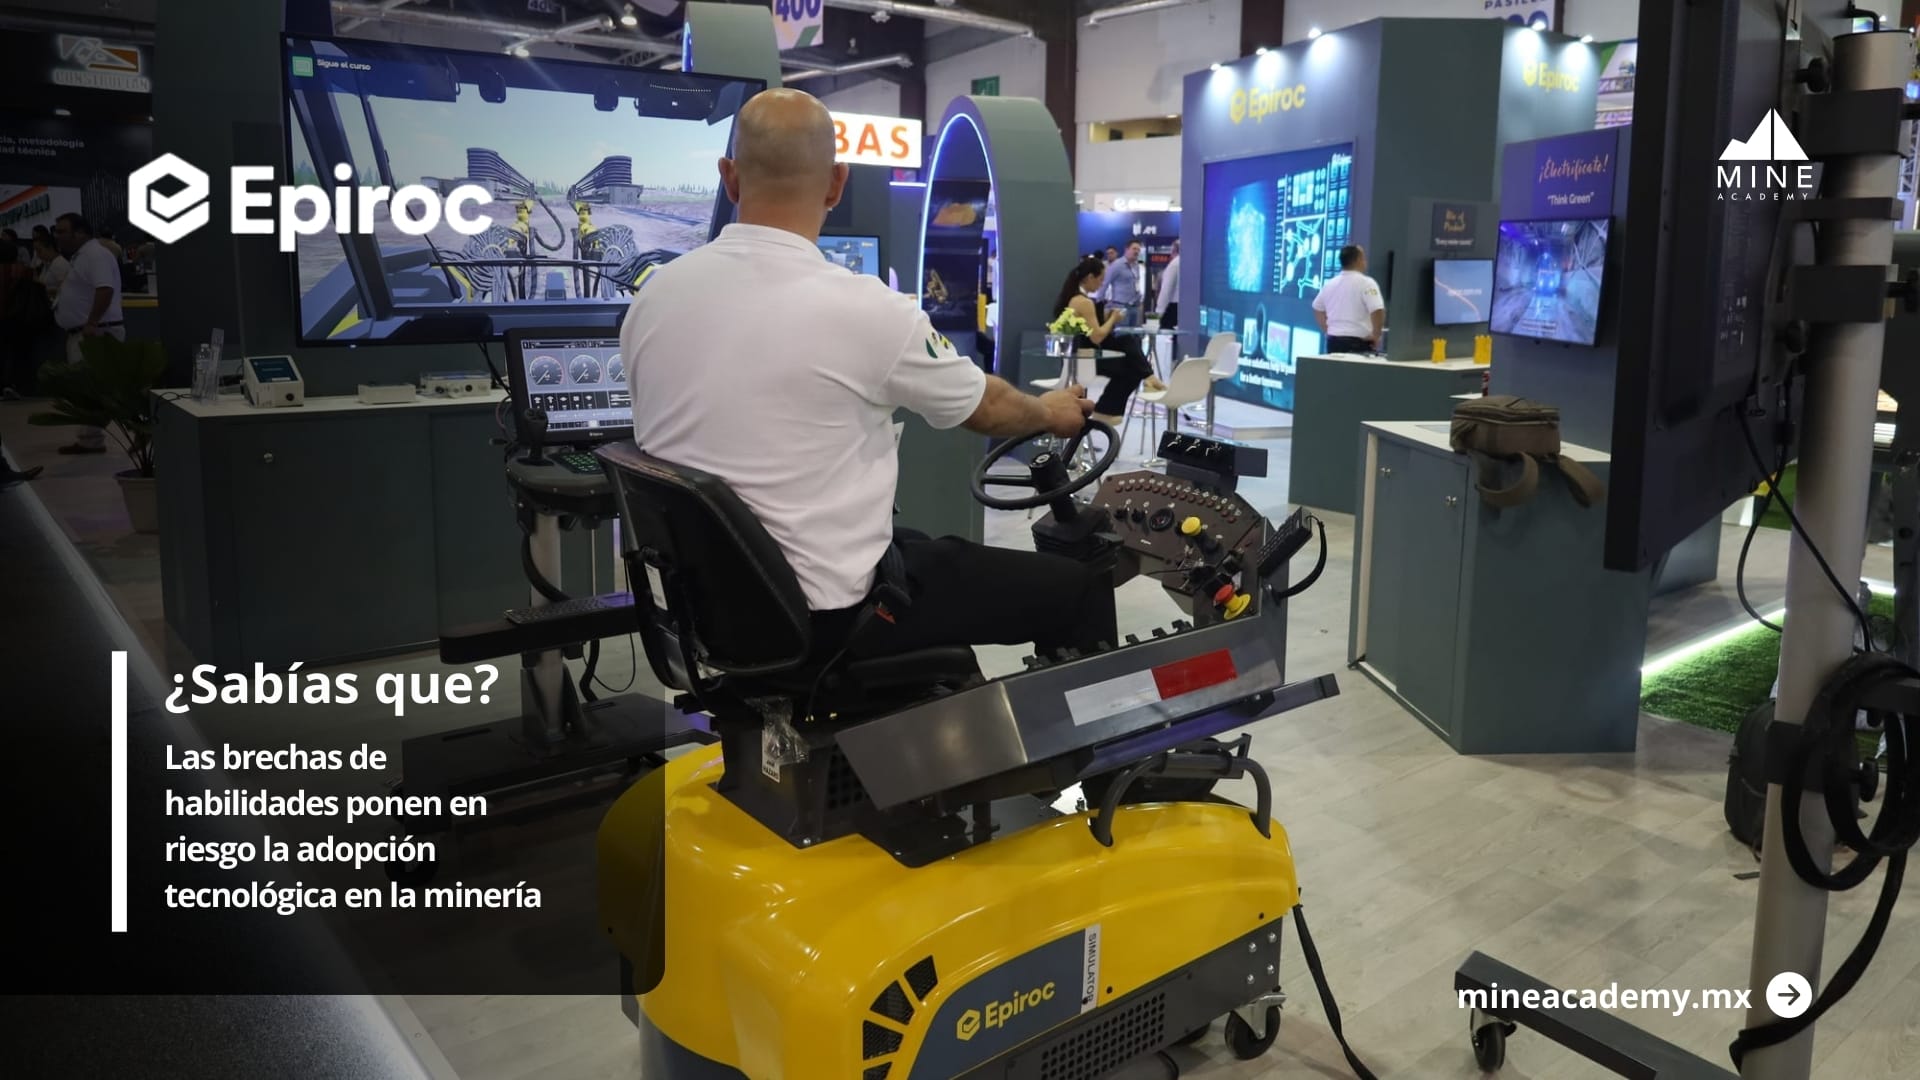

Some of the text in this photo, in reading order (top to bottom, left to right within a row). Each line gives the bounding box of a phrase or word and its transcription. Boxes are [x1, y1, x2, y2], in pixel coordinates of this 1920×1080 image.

[317, 58, 339, 69] Sigue
[340, 61, 348, 69] el
[1538, 62, 1580, 94] Epiroc
[1247, 84, 1307, 123] Epiroc
[1086, 932, 1098, 1003] SIMULATOR
[984, 981, 1056, 1029] Epiroc
